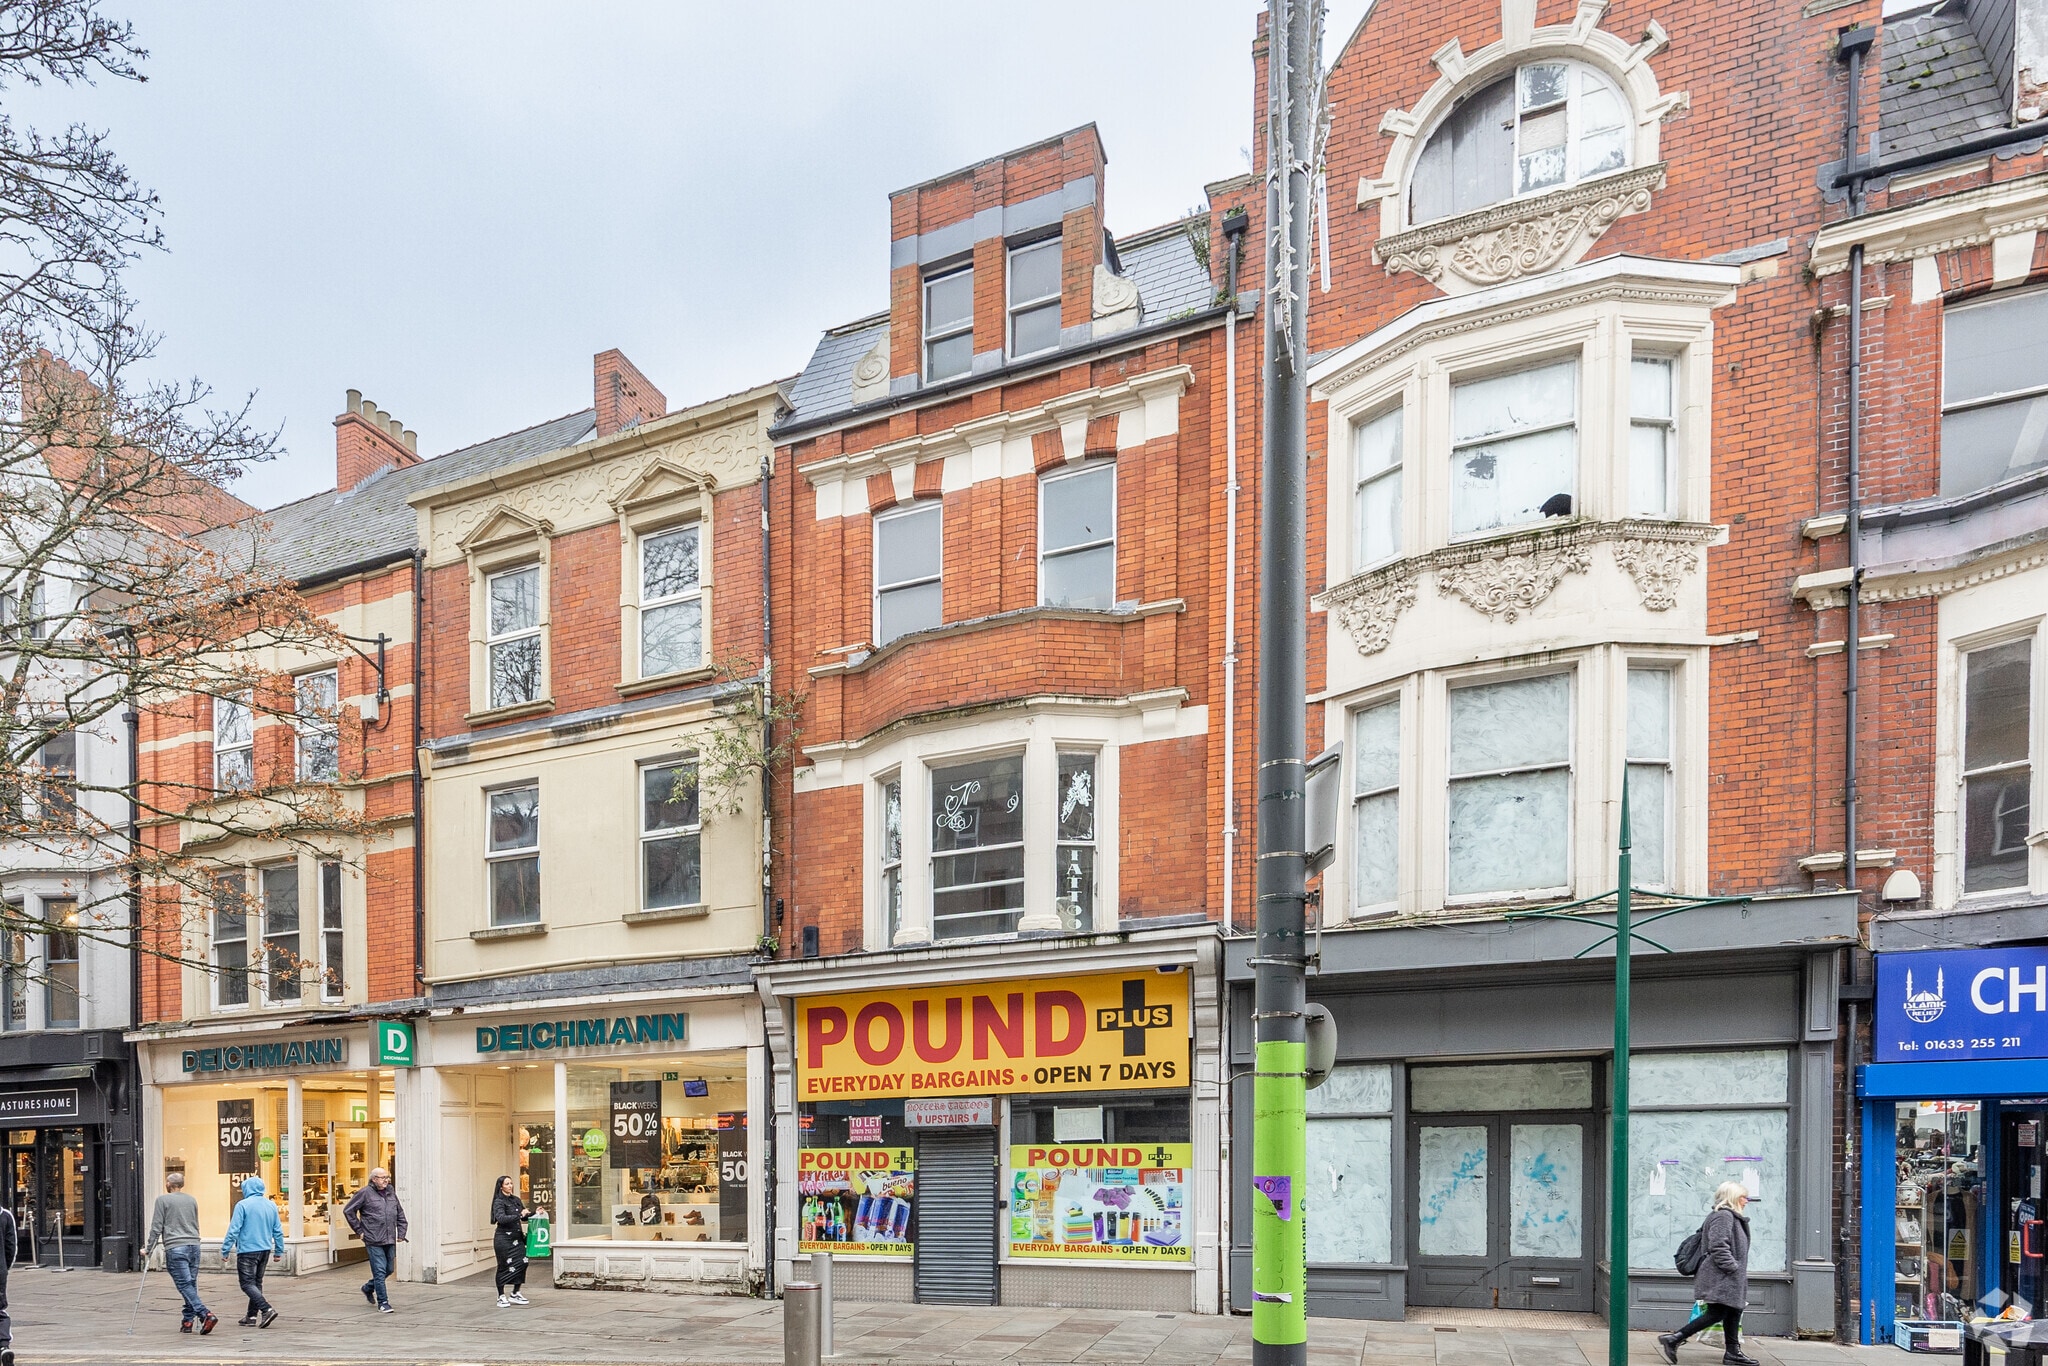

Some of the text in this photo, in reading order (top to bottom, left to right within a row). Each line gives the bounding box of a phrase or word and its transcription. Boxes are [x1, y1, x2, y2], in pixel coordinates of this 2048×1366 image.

[1066, 849, 1083, 930] TATTOO
[1970, 966, 2046, 1015] CH
[1903, 1001, 1947, 1009] ISLAMIC
[476, 1013, 685, 1054] DEICHMANN
[807, 990, 1169, 1068] POUND PLUS
[387, 1029, 408, 1054] D
[1898, 1037, 2021, 1051] Tel: 01633 255 211
[182, 1037, 343, 1073] DEICHMANN
[807, 1060, 1176, 1094] EVERYDAY BARGAINS OPEN 7 DAYS
[43, 1097, 71, 1108] HOME
[614, 1102, 637, 1110] BLACK
[947, 1100, 990, 1111] TATTOOS
[220, 1117, 237, 1125] BLACK
[613, 1113, 658, 1137] 50%
[851, 1116, 880, 1128] TO LET
[925, 1113, 970, 1124] UPSTAIRS
[220, 1126, 252, 1147] 50%
[800, 1152, 890, 1170] POUND
[1028, 1148, 1142, 1167] POUND
[882, 1177, 908, 1191] bueno
[537, 1228, 549, 1243] D
[800, 1242, 832, 1250] EVERYDAY
[833, 1243, 866, 1251] BARGAINS
[870, 1244, 888, 1252] OPEN
[895, 1244, 912, 1252] DAYS
[1012, 1243, 1187, 1256] EVERYDAY BARGAINS OPEN 7 DAYS
